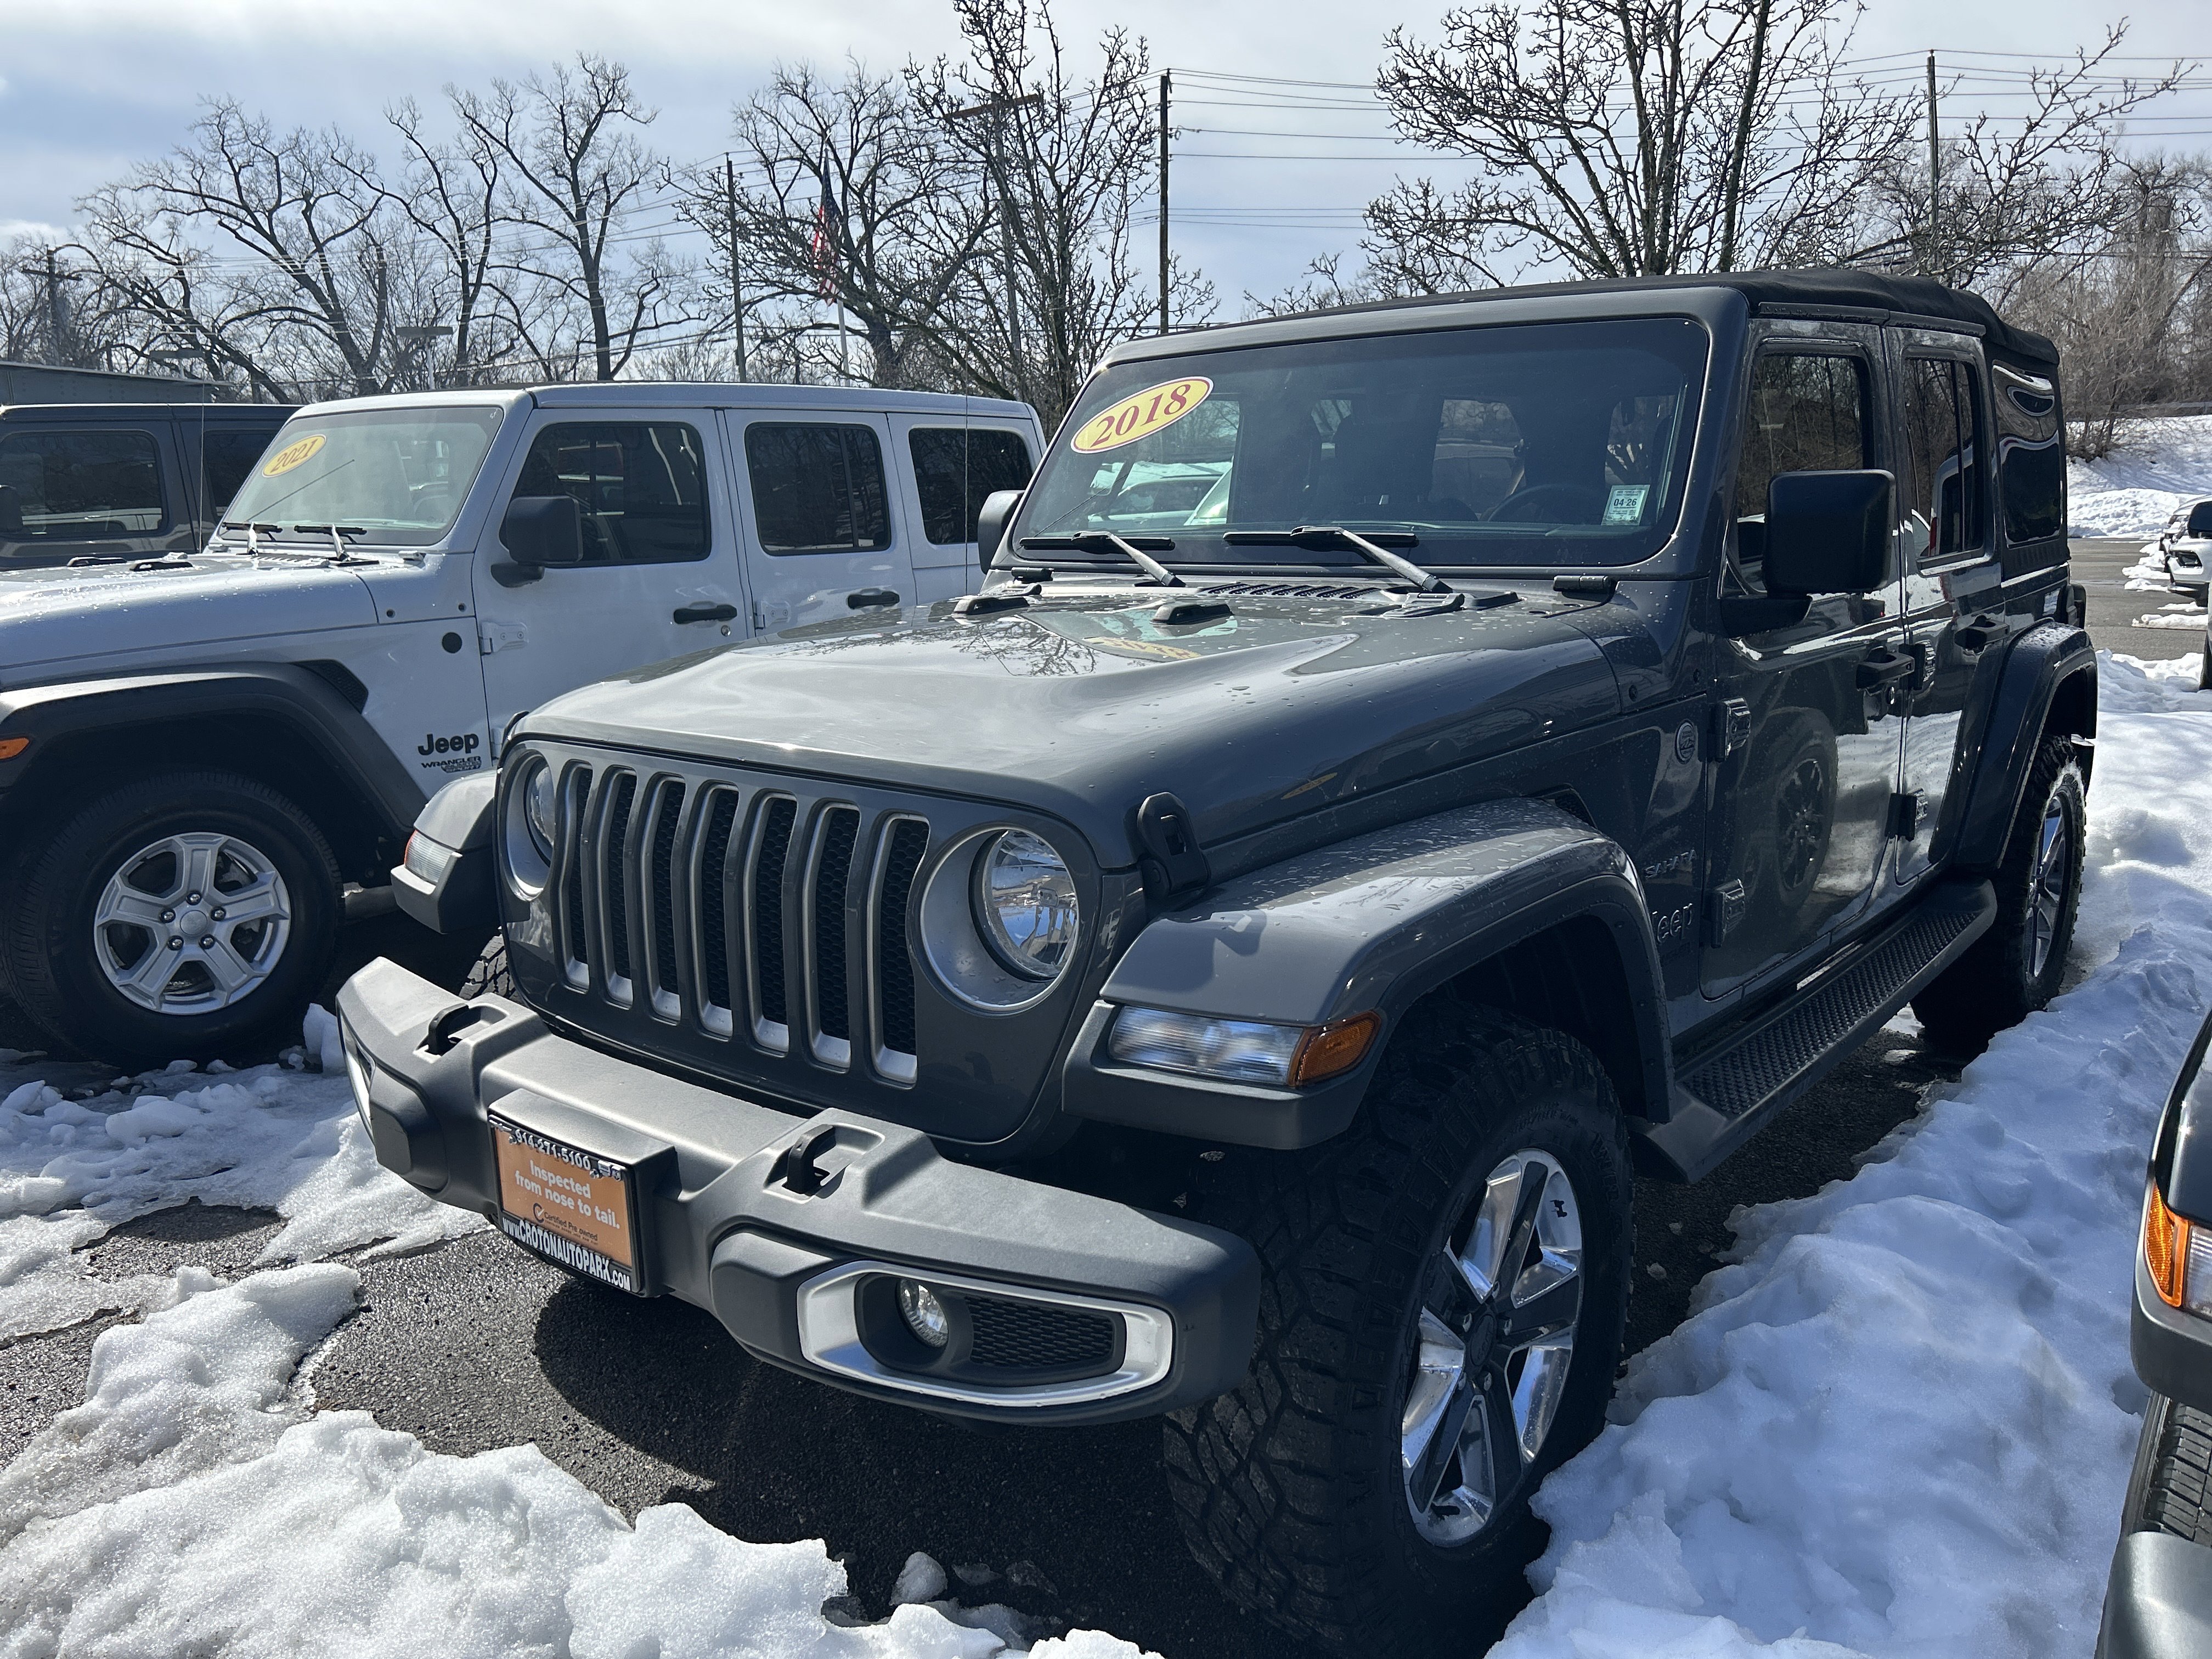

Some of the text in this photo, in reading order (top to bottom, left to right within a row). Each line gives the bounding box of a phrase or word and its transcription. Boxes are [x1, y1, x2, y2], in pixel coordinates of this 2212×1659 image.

[1090, 384, 1191, 448] 2018
[270, 438, 318, 473] 2021
[418, 733, 479, 755] Jeep
[421, 756, 481, 768] WRANGLER
[529, 1159, 591, 1199] Inspected
[515, 1170, 620, 1229] from nose to tail.
[544, 1211, 567, 1227] Certified
